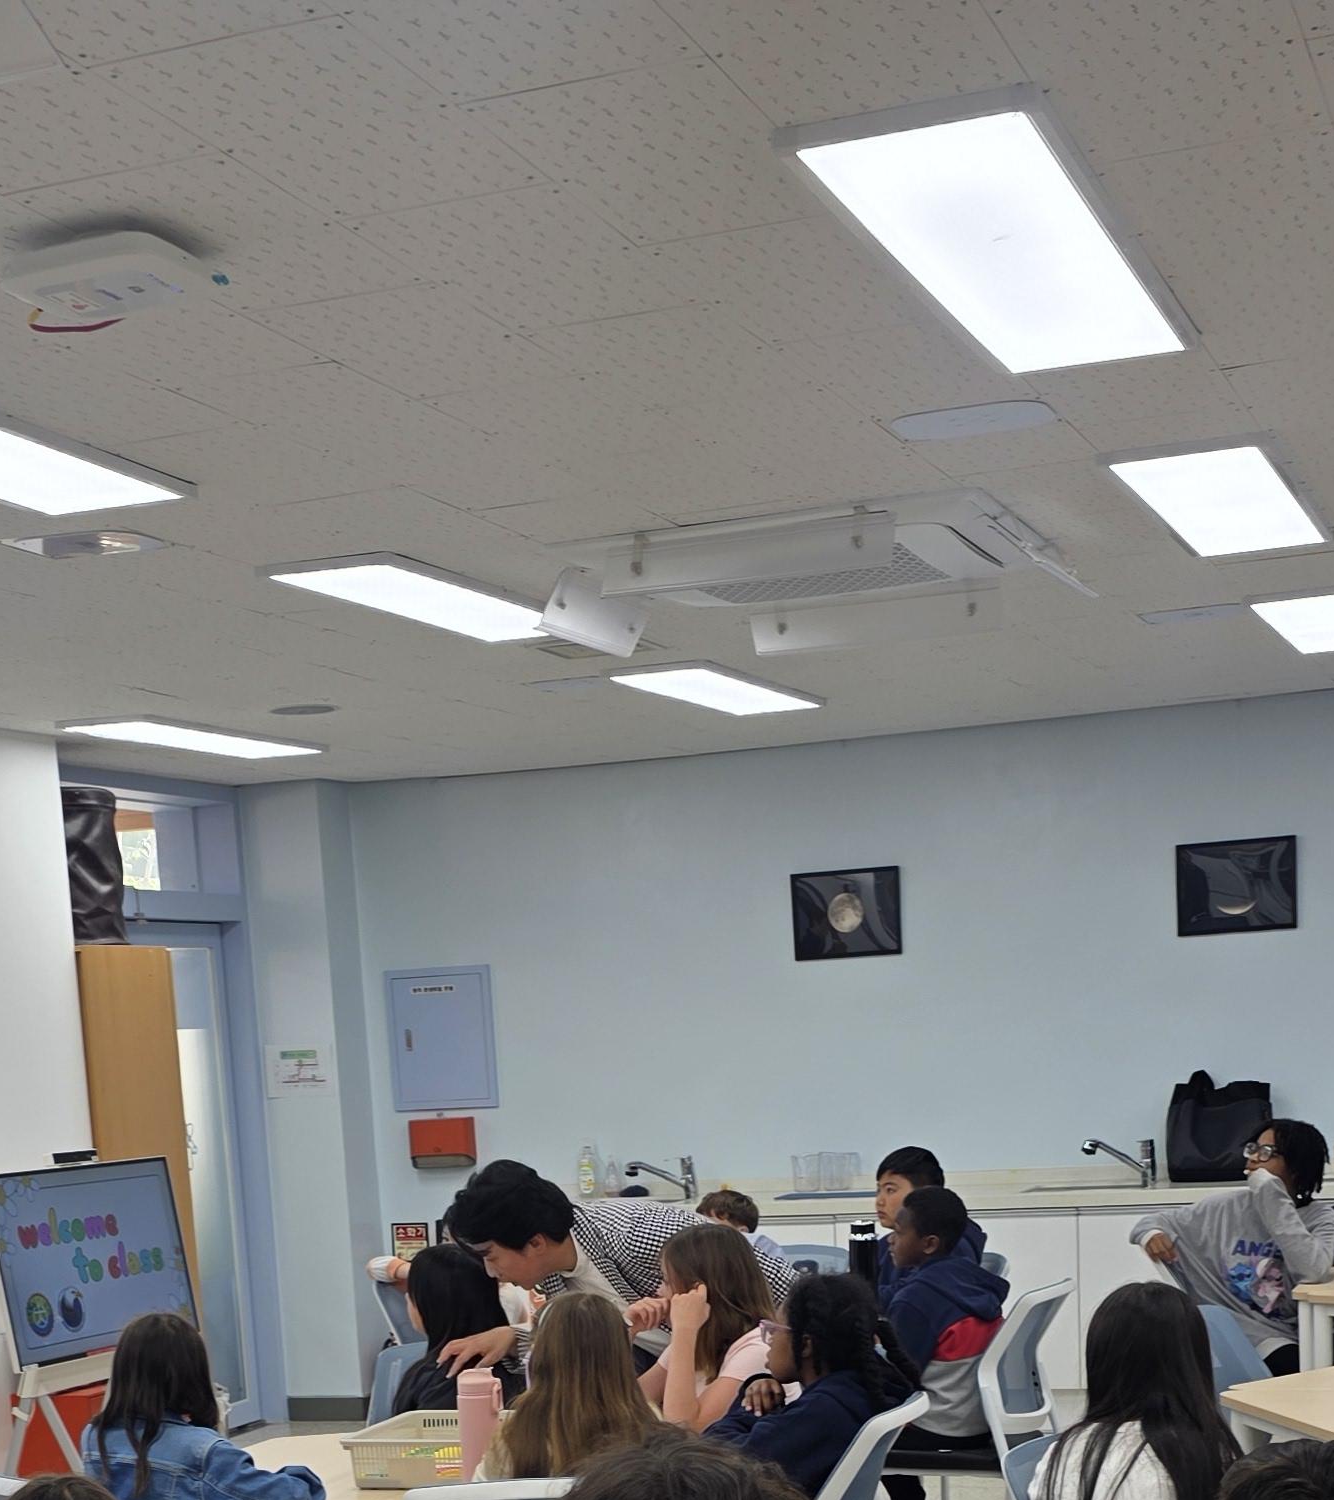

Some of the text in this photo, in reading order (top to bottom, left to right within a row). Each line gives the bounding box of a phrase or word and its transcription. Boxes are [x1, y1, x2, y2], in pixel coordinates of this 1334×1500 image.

[17, 1207, 119, 1249] welcome
[396, 1227, 426, 1238] 소화기
[72, 1240, 164, 1284] to class
